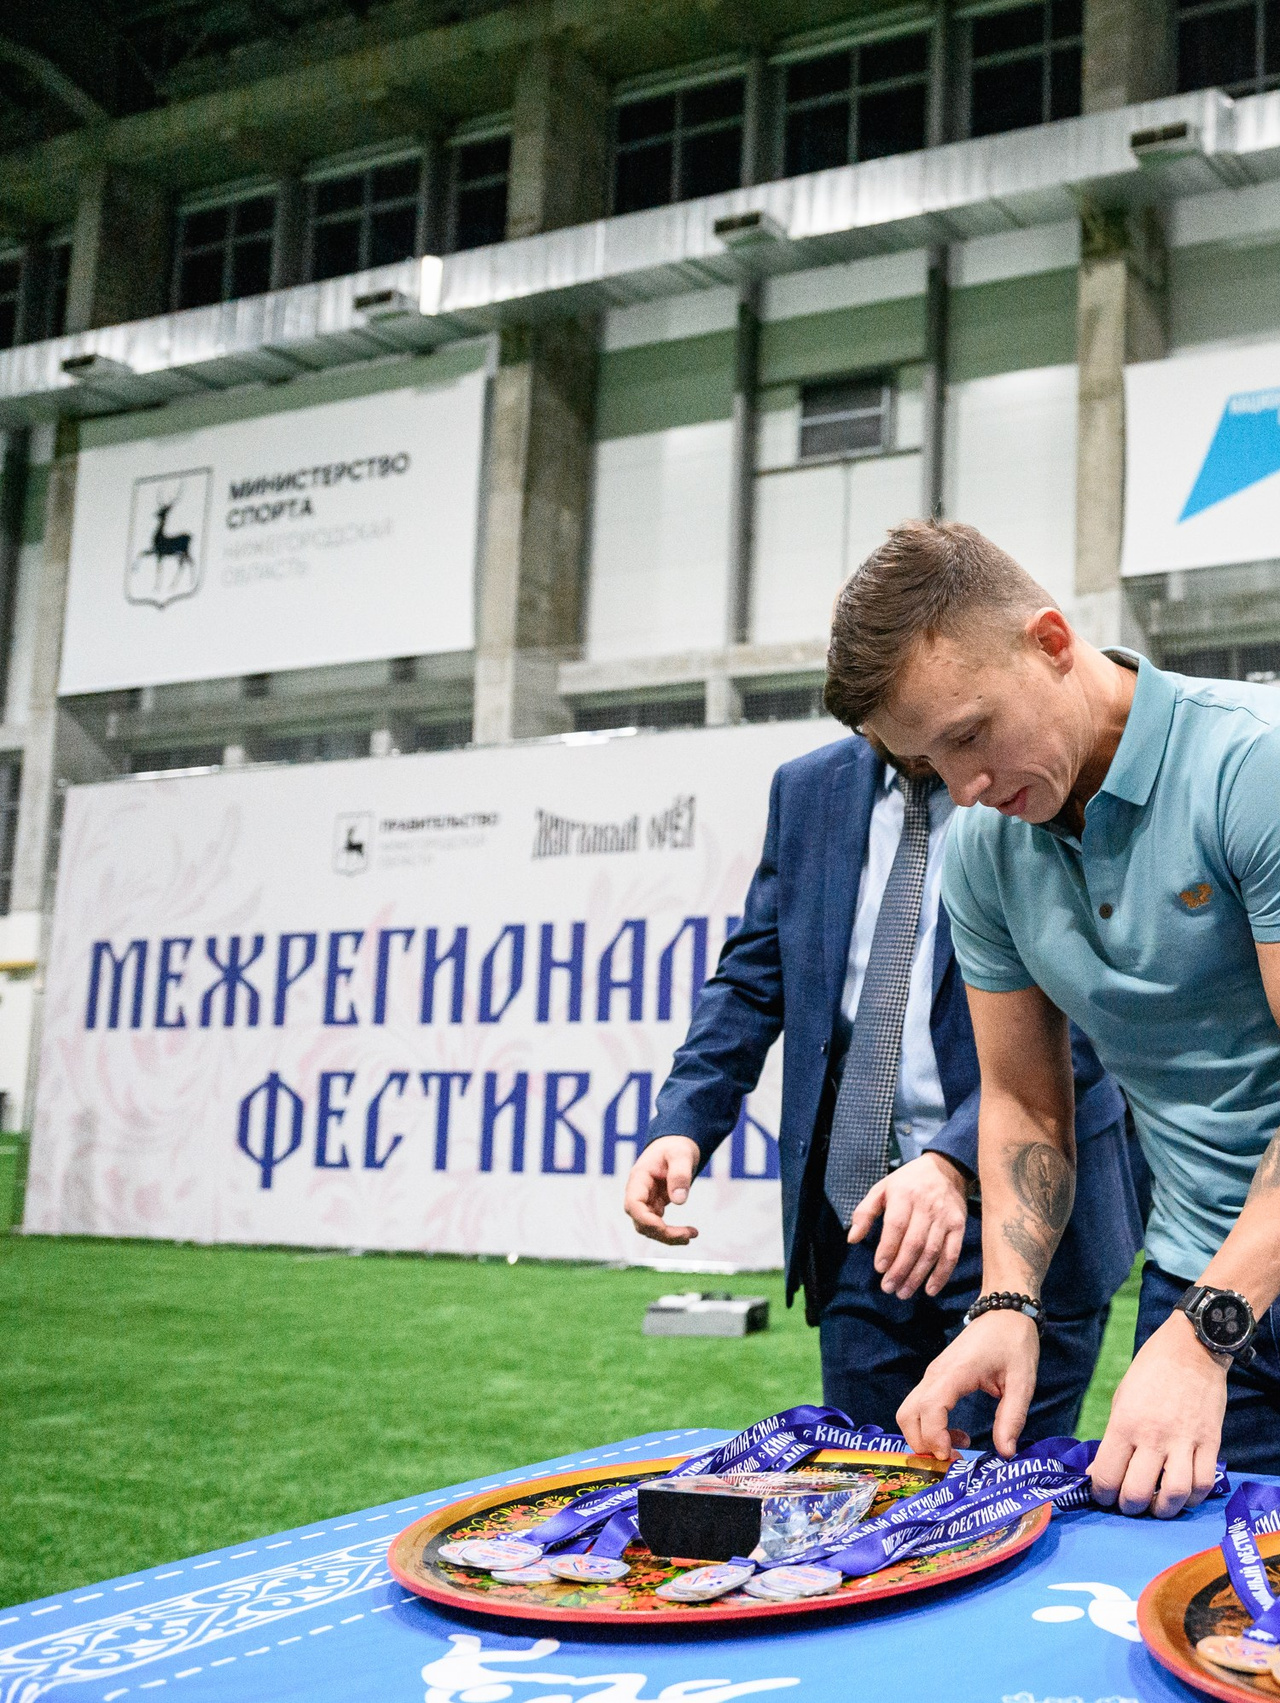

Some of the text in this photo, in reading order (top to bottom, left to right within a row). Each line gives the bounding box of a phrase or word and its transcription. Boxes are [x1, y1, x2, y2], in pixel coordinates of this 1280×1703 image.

[229, 452, 411, 499] МИНИСТЕРСТВО
[226, 499, 314, 530] СПОРТА
[85, 915, 743, 1031] МЕЖРЕГИОНАЛ
[237, 1071, 781, 1190] ФЕСТИВАЬ
[948, 1497, 1022, 1539] ФЕСТИВАЛЬ
